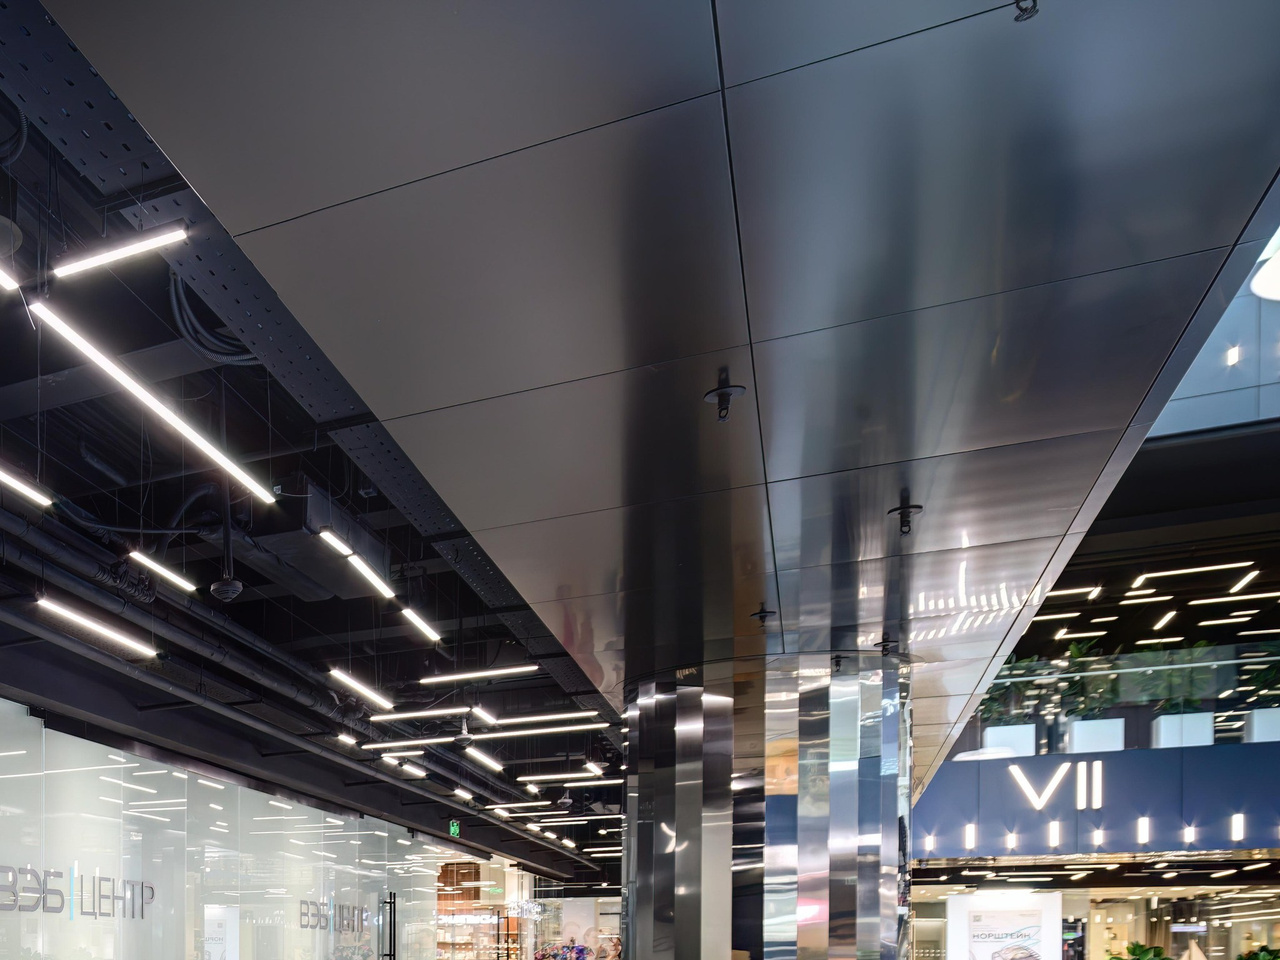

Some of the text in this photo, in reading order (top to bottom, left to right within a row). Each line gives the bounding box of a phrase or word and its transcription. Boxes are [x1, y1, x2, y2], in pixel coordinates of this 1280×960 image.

[1007, 760, 1103, 811] VII
[80, 874, 156, 920] ЦЕНТР
[300, 899, 329, 930] ВЭБ
